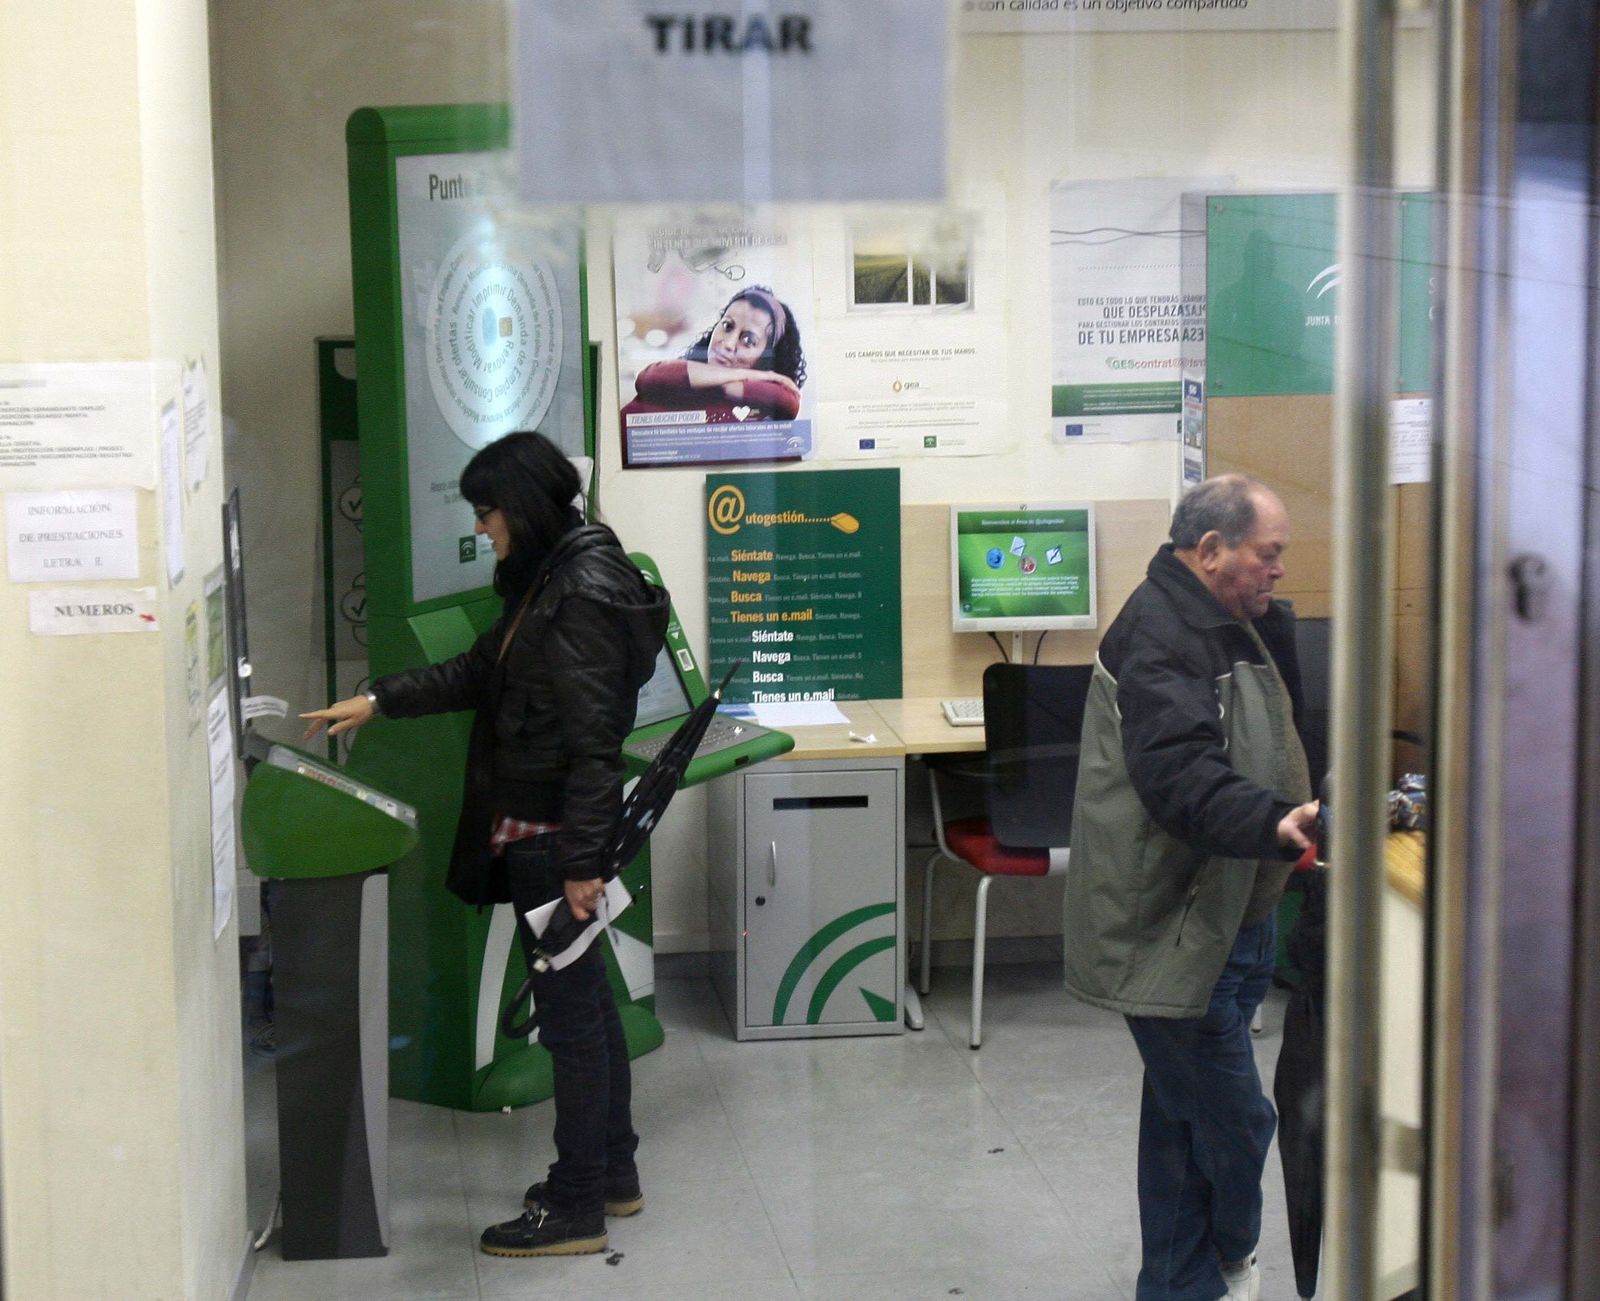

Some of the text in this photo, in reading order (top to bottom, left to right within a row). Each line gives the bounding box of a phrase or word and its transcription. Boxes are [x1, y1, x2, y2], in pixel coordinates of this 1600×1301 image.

[644, 14, 812, 56] TIRAR
[1078, 297, 1094, 306] ESTO
[1096, 297, 1104, 305] ES
[1106, 296, 1123, 305] TODO
[1135, 296, 1147, 304] QUE
[1103, 306, 1124, 319] QUE
[1078, 320, 1094, 329] PARA
[1096, 319, 1130, 328] GESTIONAR
[1305, 315, 1330, 326] JUNTA
[1078, 328, 1180, 345] DE TU EMPRESA
[898, 349, 930, 357] NECESITAN
[904, 381, 920, 391] gea
[678, 413, 700, 422] PODER
[19, 529, 124, 543] DE PRESTACIONES
[731, 549, 774, 562] Siéntate
[43, 558, 82, 568] LETRA
[732, 570, 771, 585] Navega
[731, 590, 762, 603] Busca
[54, 603, 135, 617] NUMEROS
[730, 611, 764, 623] Tienes
[766, 613, 779, 622] un
[781, 609, 813, 622] e.mail
[752, 630, 794, 643] Siéntate
[753, 650, 791, 665] Navega
[753, 670, 784, 683] Busca
[752, 690, 786, 703] Tienes
[788, 691, 801, 702] un
[803, 688, 835, 703] e.mail
